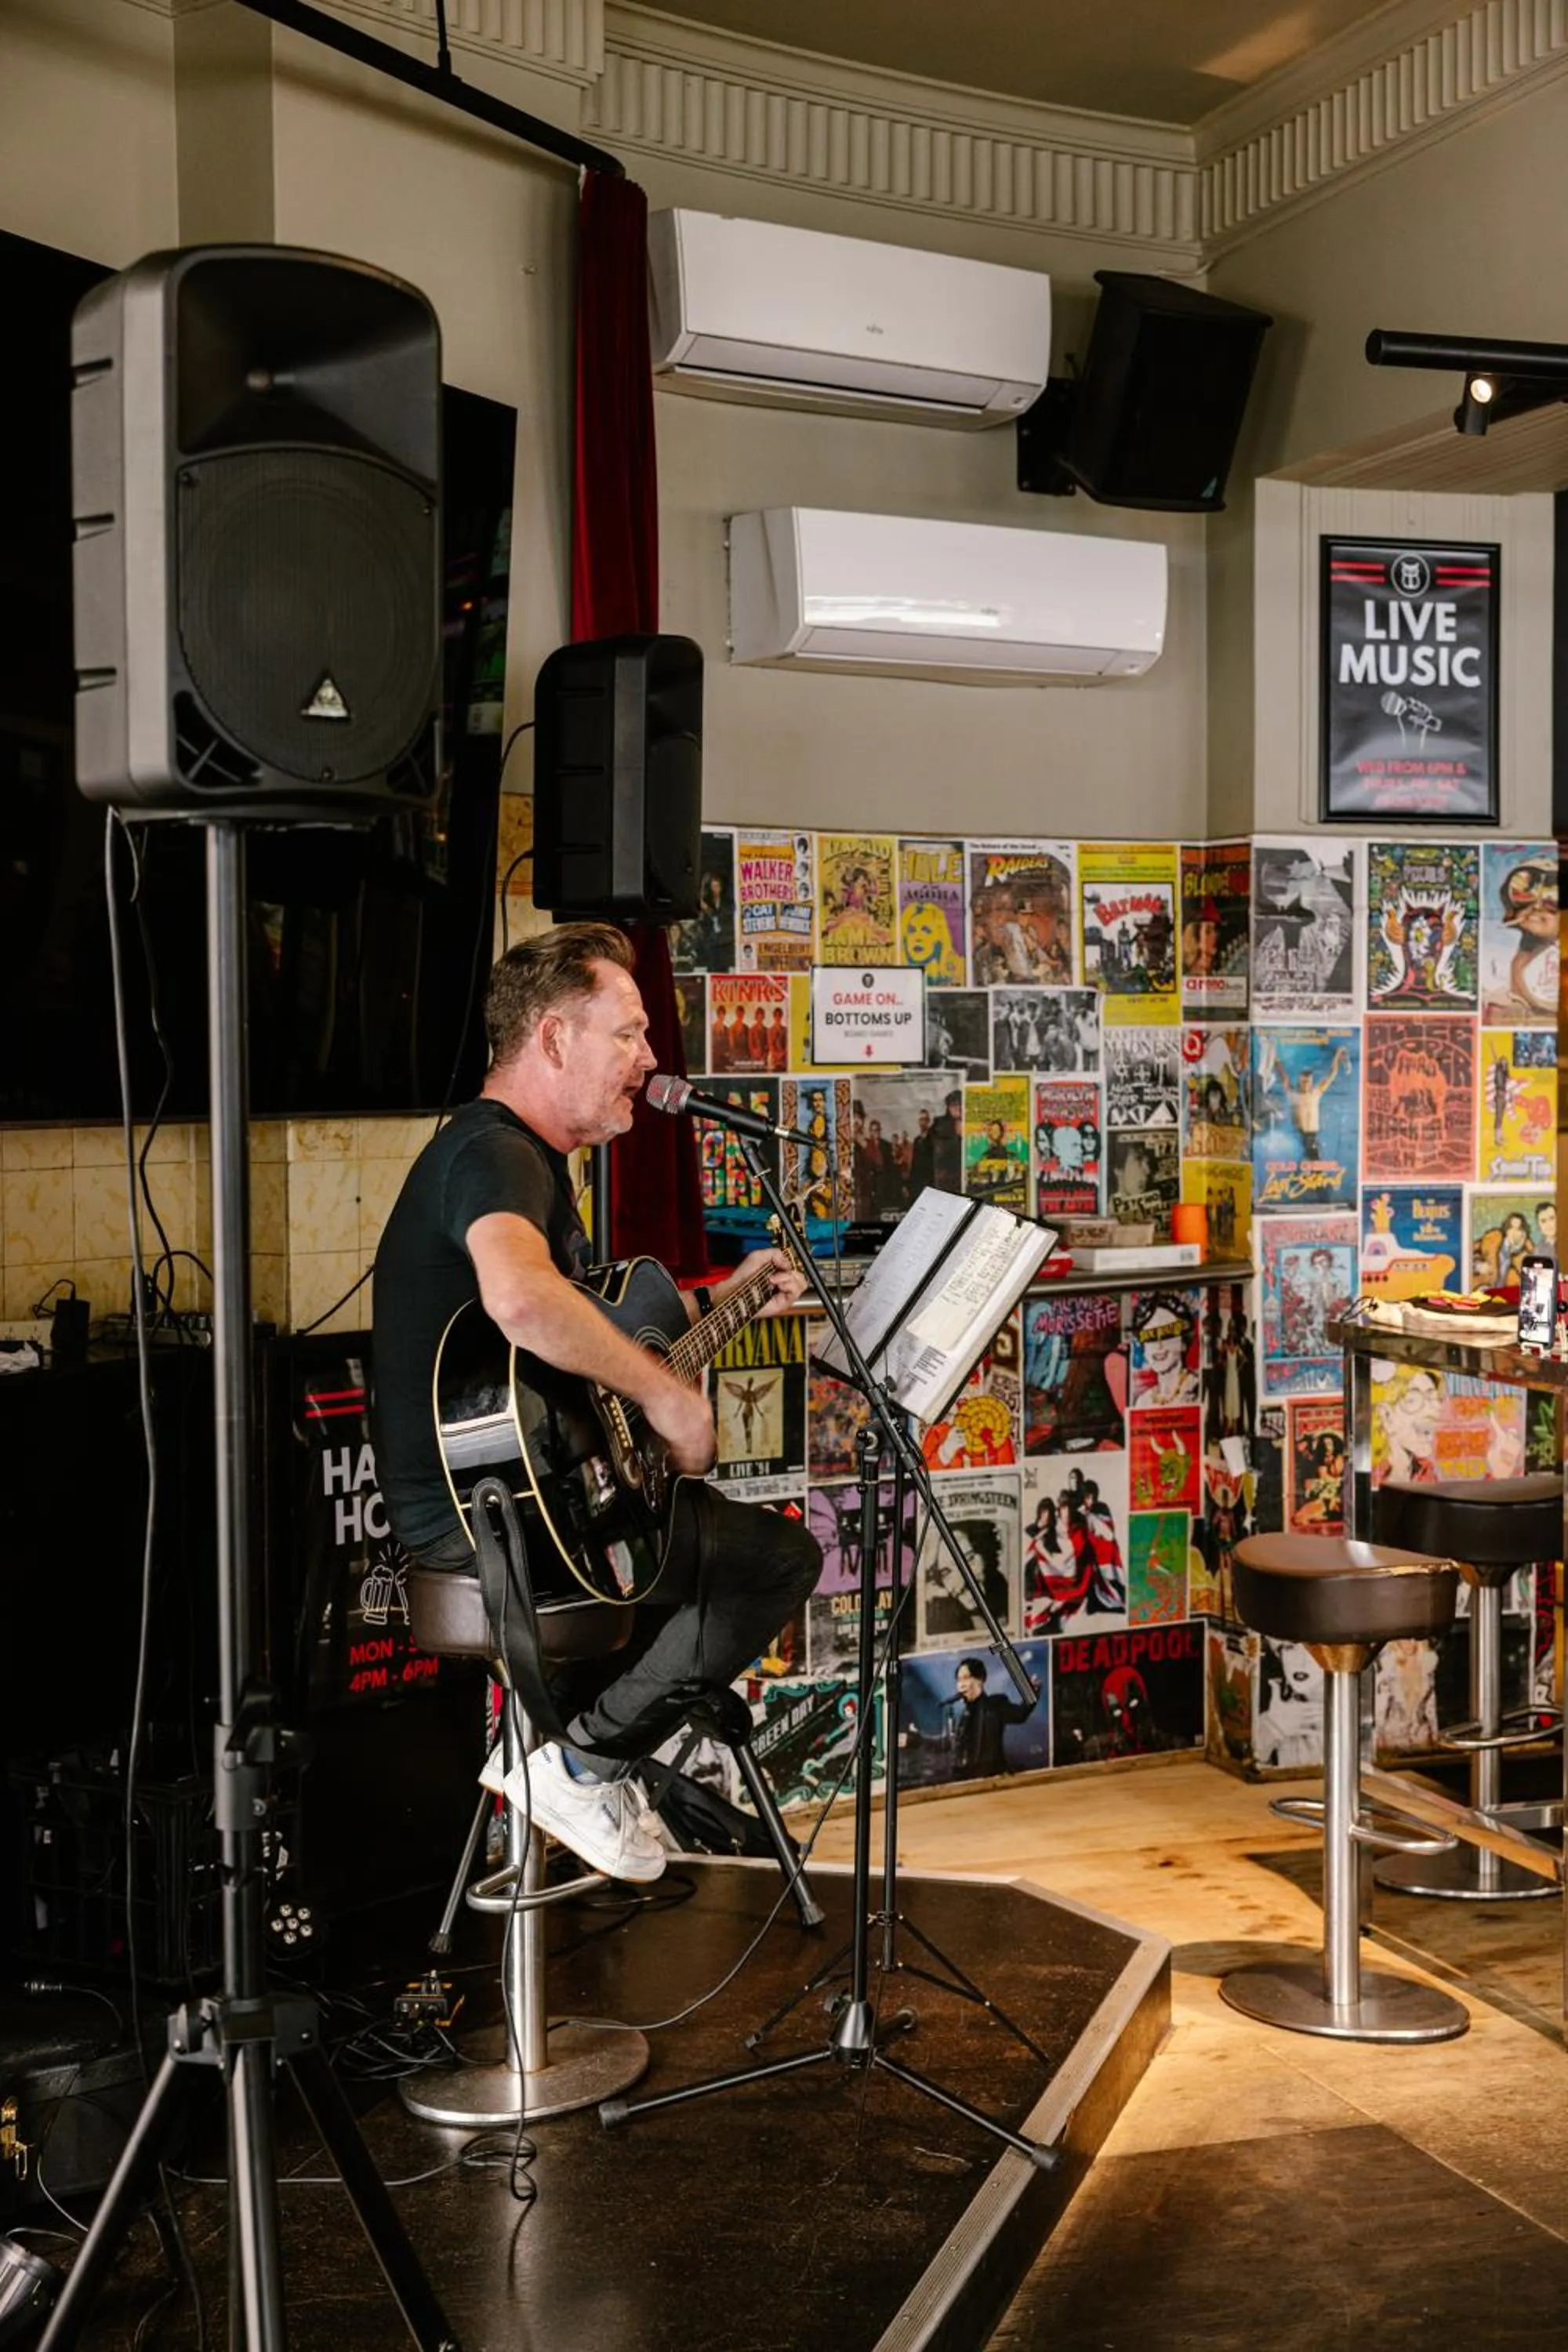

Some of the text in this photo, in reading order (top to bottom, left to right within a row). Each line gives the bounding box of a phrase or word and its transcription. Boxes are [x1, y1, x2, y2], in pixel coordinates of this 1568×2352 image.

[1364, 599, 1457, 642] LIVE
[1338, 644, 1482, 688] MUSIC
[740, 861, 793, 882] WALKER
[985, 854, 1049, 887] RAIDERS
[740, 884, 794, 902] BROTHERS
[752, 903, 774, 916] CAT
[1095, 897, 1163, 926] BATMAN
[825, 946, 893, 964] BROWN
[712, 979, 785, 1003] KINKS
[833, 993, 872, 1005] GAME
[825, 1012, 913, 1025] BOTTOMS UP
[1184, 1033, 1203, 1057] Q
[1032, 1303, 1118, 1334] MORISSETTE
[714, 1316, 804, 1368] RVANA
[730, 1462, 753, 1478] LIVE
[949, 1491, 1018, 1510] SPRINGSTEEN
[336, 1491, 391, 1545] HO
[831, 1589, 893, 1615] COLDAY
[350, 1637, 392, 1667] MON
[1058, 1628, 1200, 1673] DEADPOOL
[349, 1665, 387, 1693] 4PM
[402, 1657, 439, 1683] 6PM
